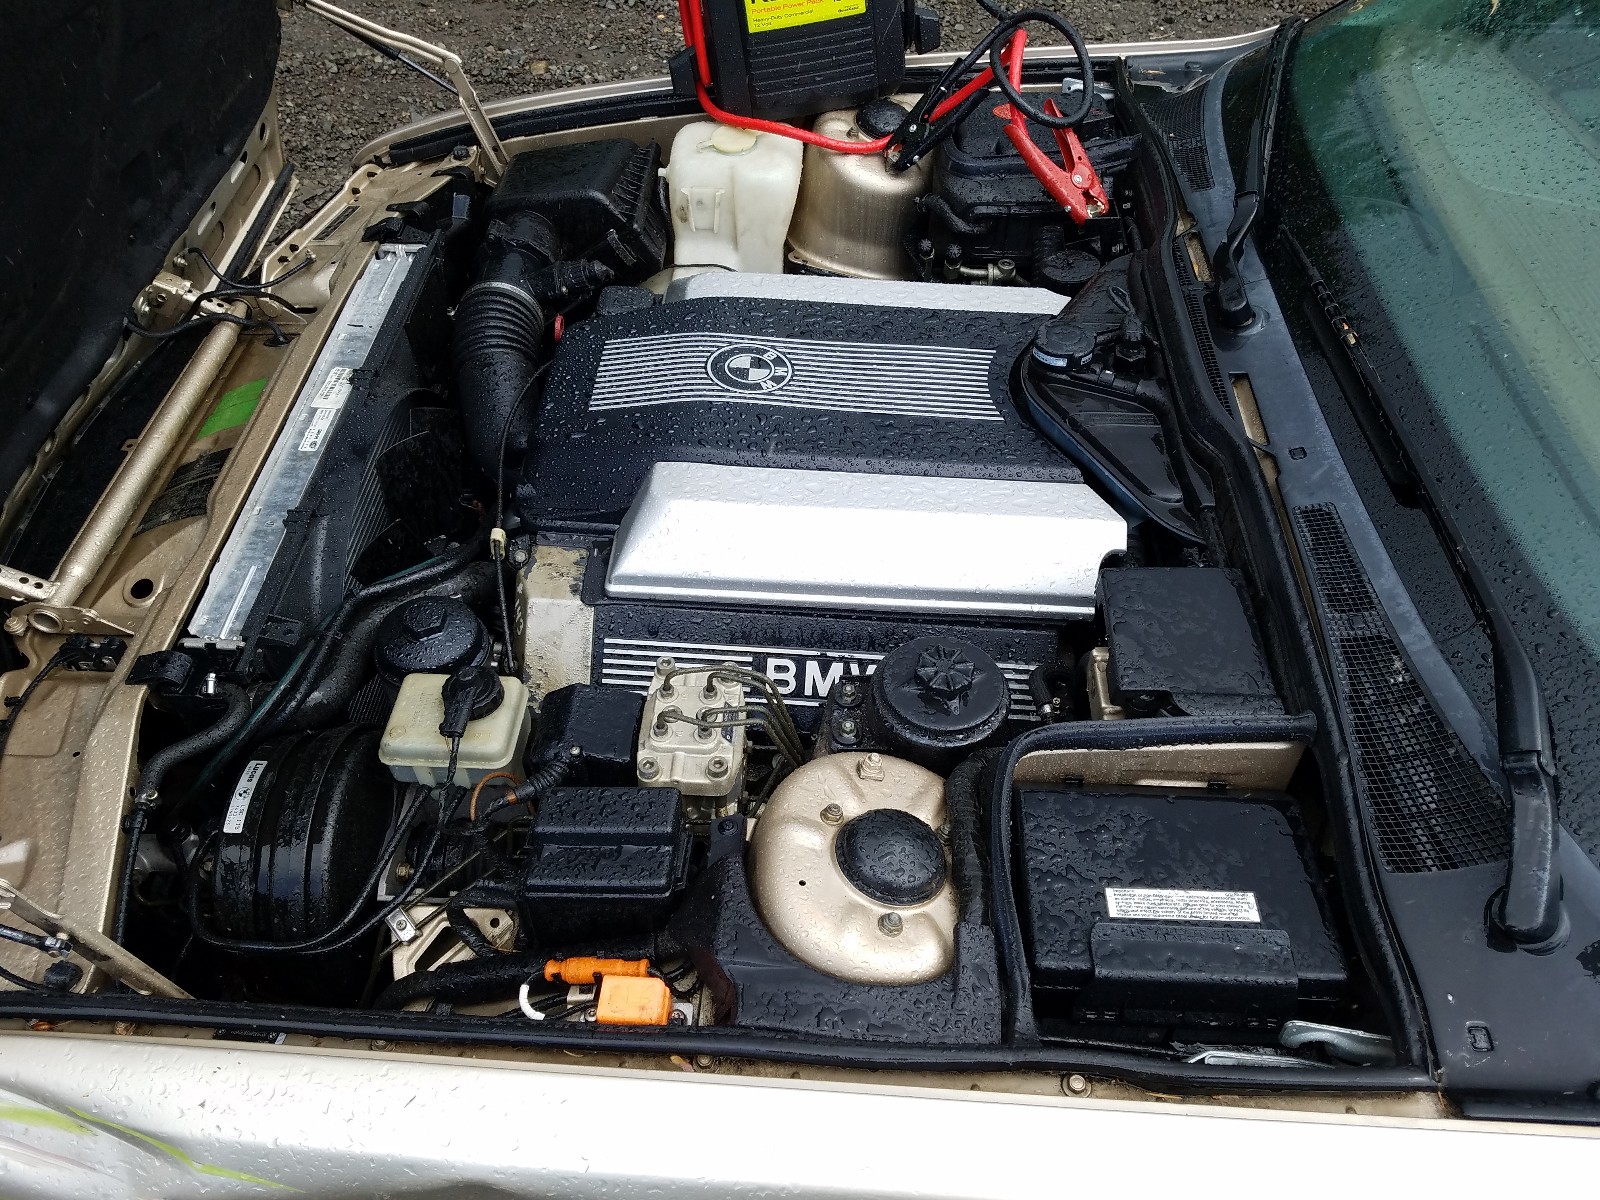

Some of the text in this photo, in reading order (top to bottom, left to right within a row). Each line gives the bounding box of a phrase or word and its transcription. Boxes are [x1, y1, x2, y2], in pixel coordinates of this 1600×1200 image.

[751, 6, 782, 14] Portable
[782, 1, 805, 9] Power
[246, 762, 264, 783] Lucas
